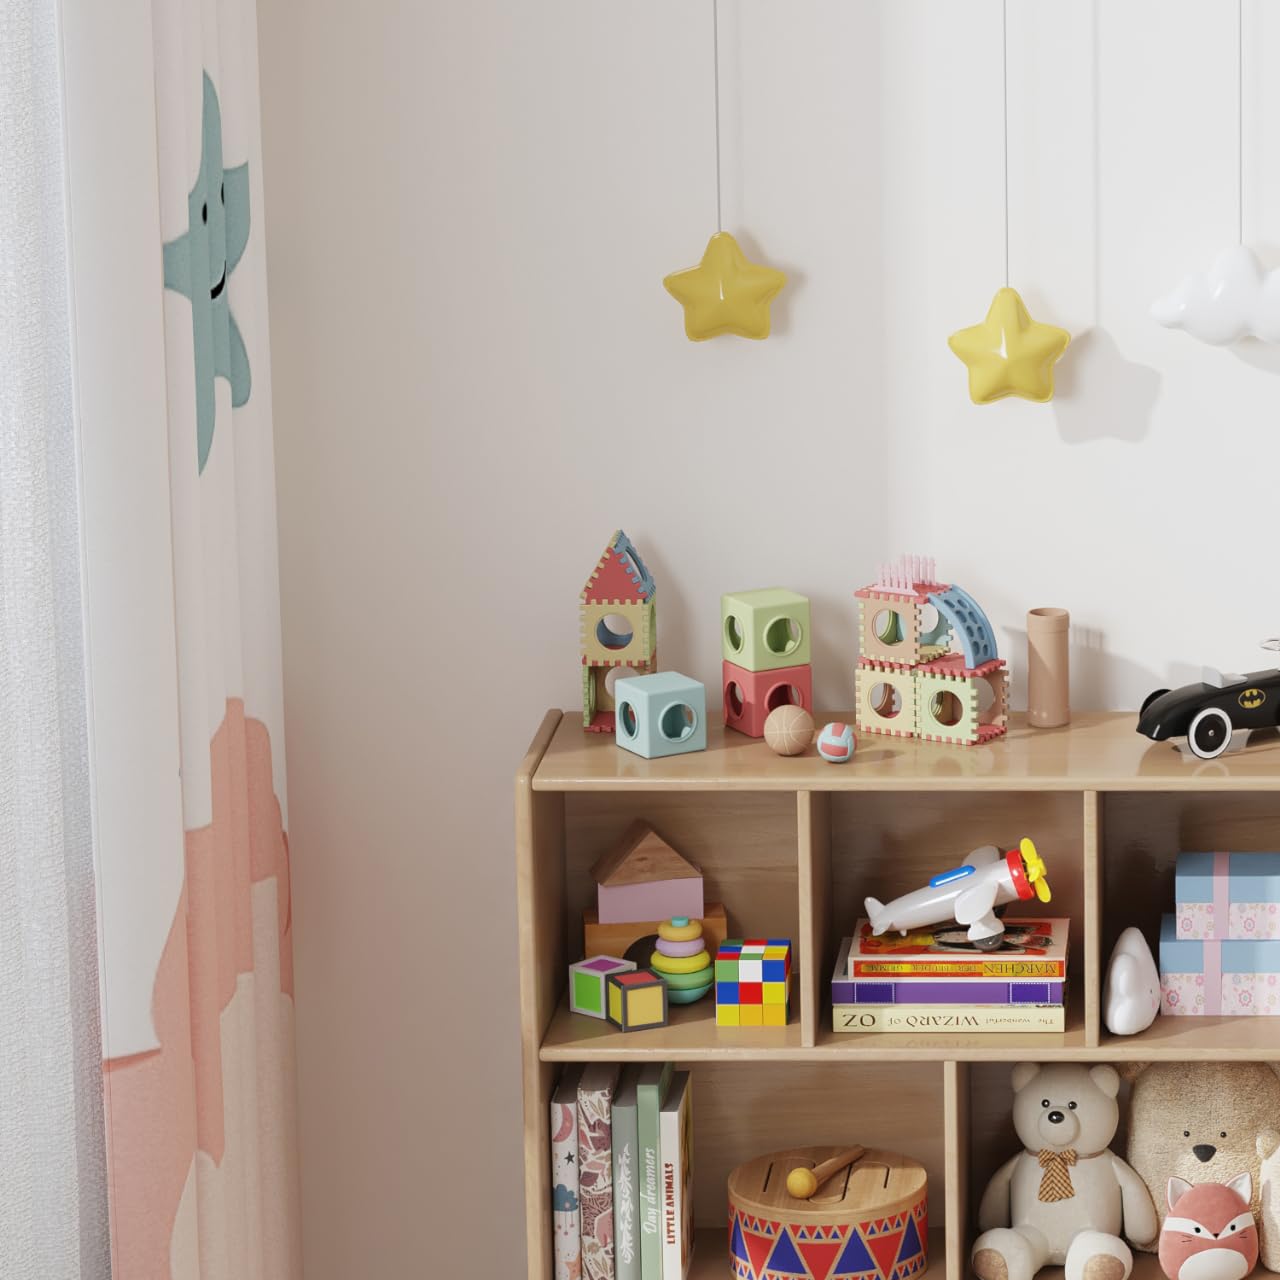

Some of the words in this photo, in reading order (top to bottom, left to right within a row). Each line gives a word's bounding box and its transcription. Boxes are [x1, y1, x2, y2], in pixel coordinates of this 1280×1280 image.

[842, 1014, 876, 1027] OZ
[640, 1148, 657, 1205] dreamers
[664, 1162, 675, 1207] ANIMALS
[643, 1208, 661, 1234] Day
[665, 1209, 676, 1245] LITTLE
